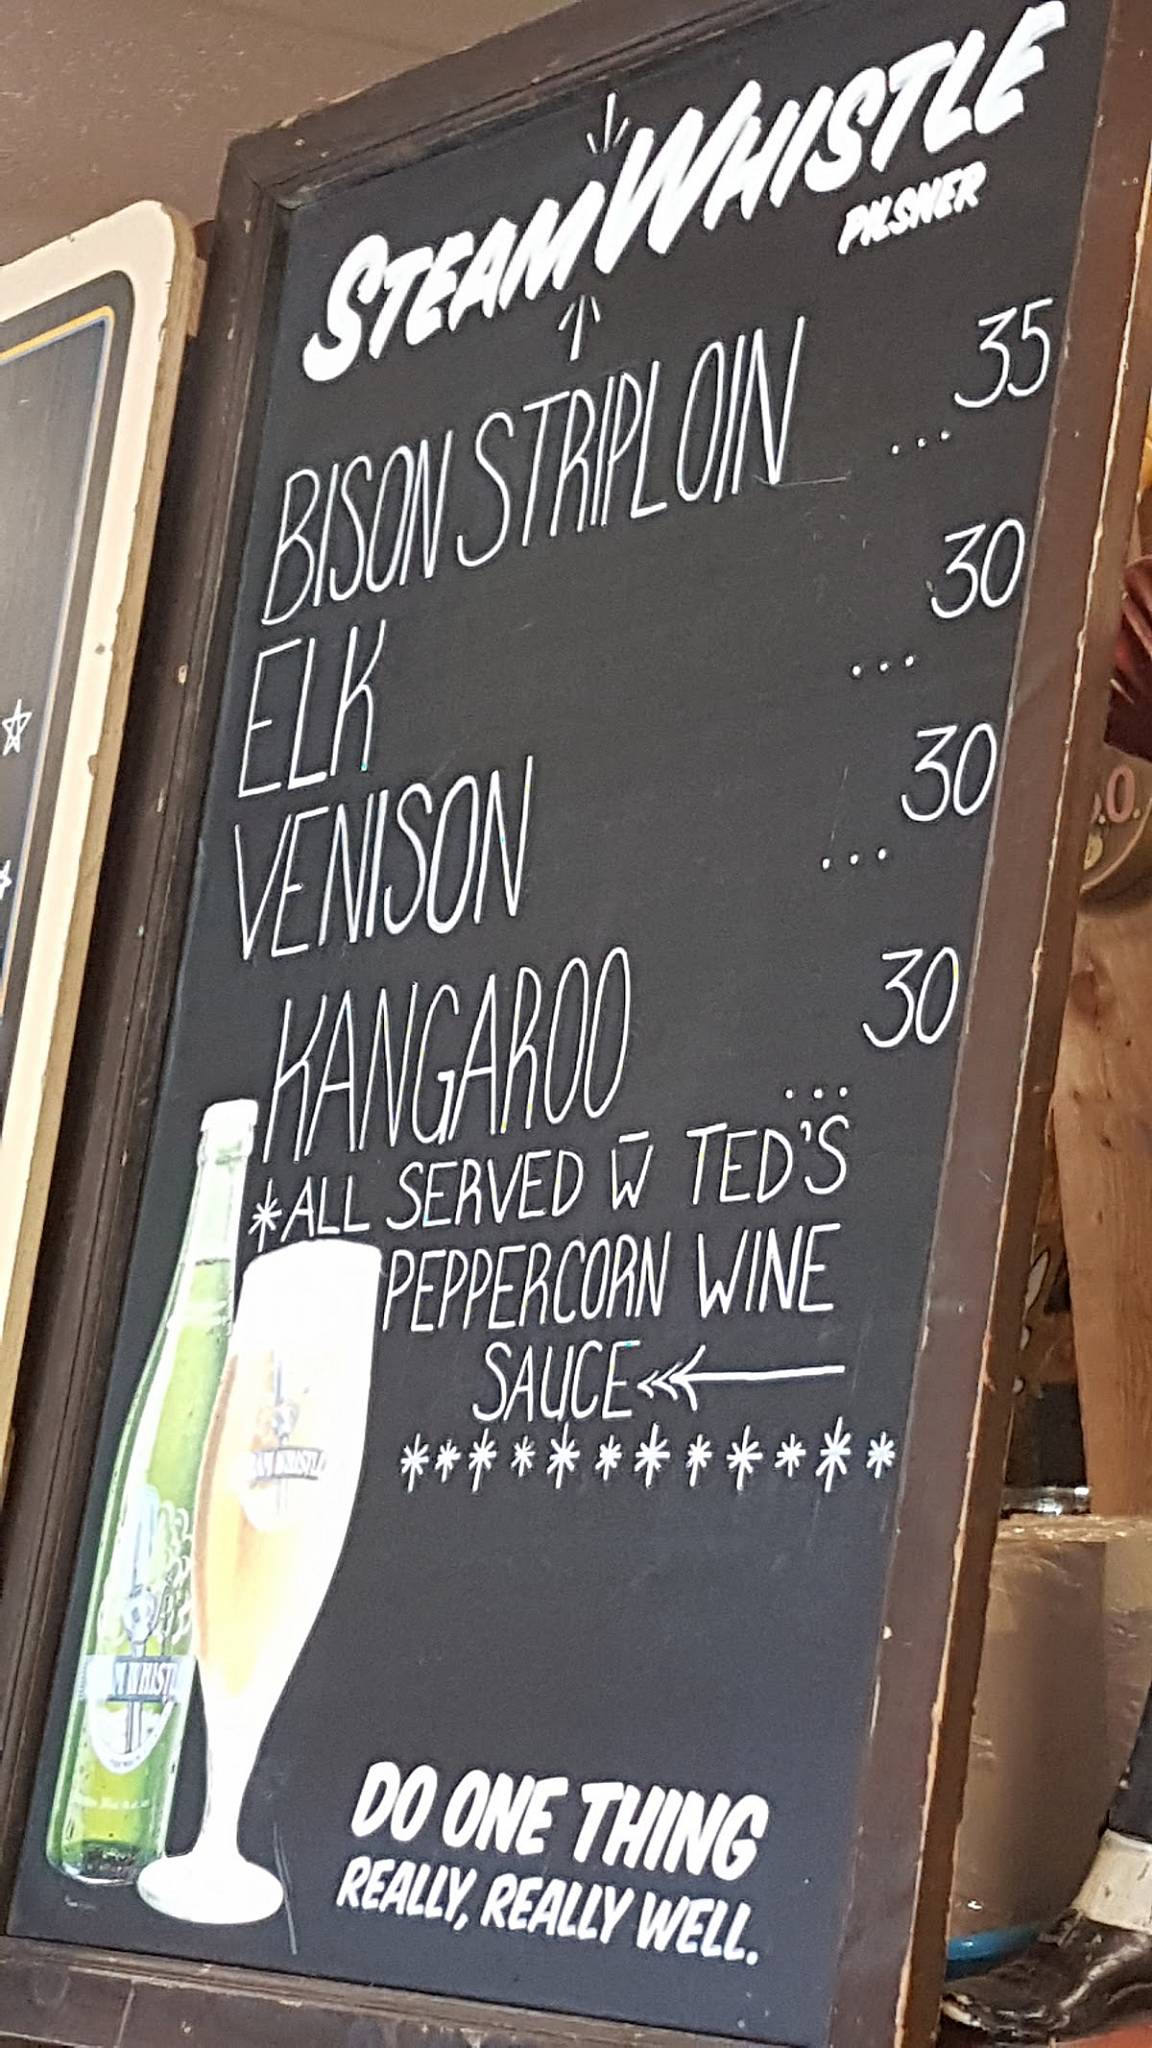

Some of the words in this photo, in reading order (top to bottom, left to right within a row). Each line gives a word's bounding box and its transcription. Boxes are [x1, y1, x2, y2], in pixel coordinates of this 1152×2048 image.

[837, 161, 987, 255] PILSNER
[954, 297, 1053, 408] 35
[261, 430, 453, 626] BISON
[457, 316, 805, 567] STRIPLOIN
[931, 518, 1026, 619] 30
[238, 619, 387, 798] ELK
[901, 723, 998, 822] 30
[234, 755, 533, 961] VENISON
[862, 946, 960, 1048] 30
[262, 946, 631, 1164] KANGAROO
[386, 1149, 584, 1231] SERVED
[686, 1114, 850, 1205] TED'S
[382, 1231, 671, 1332] PEPPERCORN
[697, 1222, 841, 1319] WINE
[472, 1339, 641, 1422] SAUCE
[351, 1761, 438, 1842] DO
[442, 1769, 569, 1856] ONE
[573, 1781, 770, 1881] THING
[336, 1855, 478, 1931] REALLY,
[480, 1873, 635, 1945] REALLY
[636, 1891, 759, 1966] WELL.
